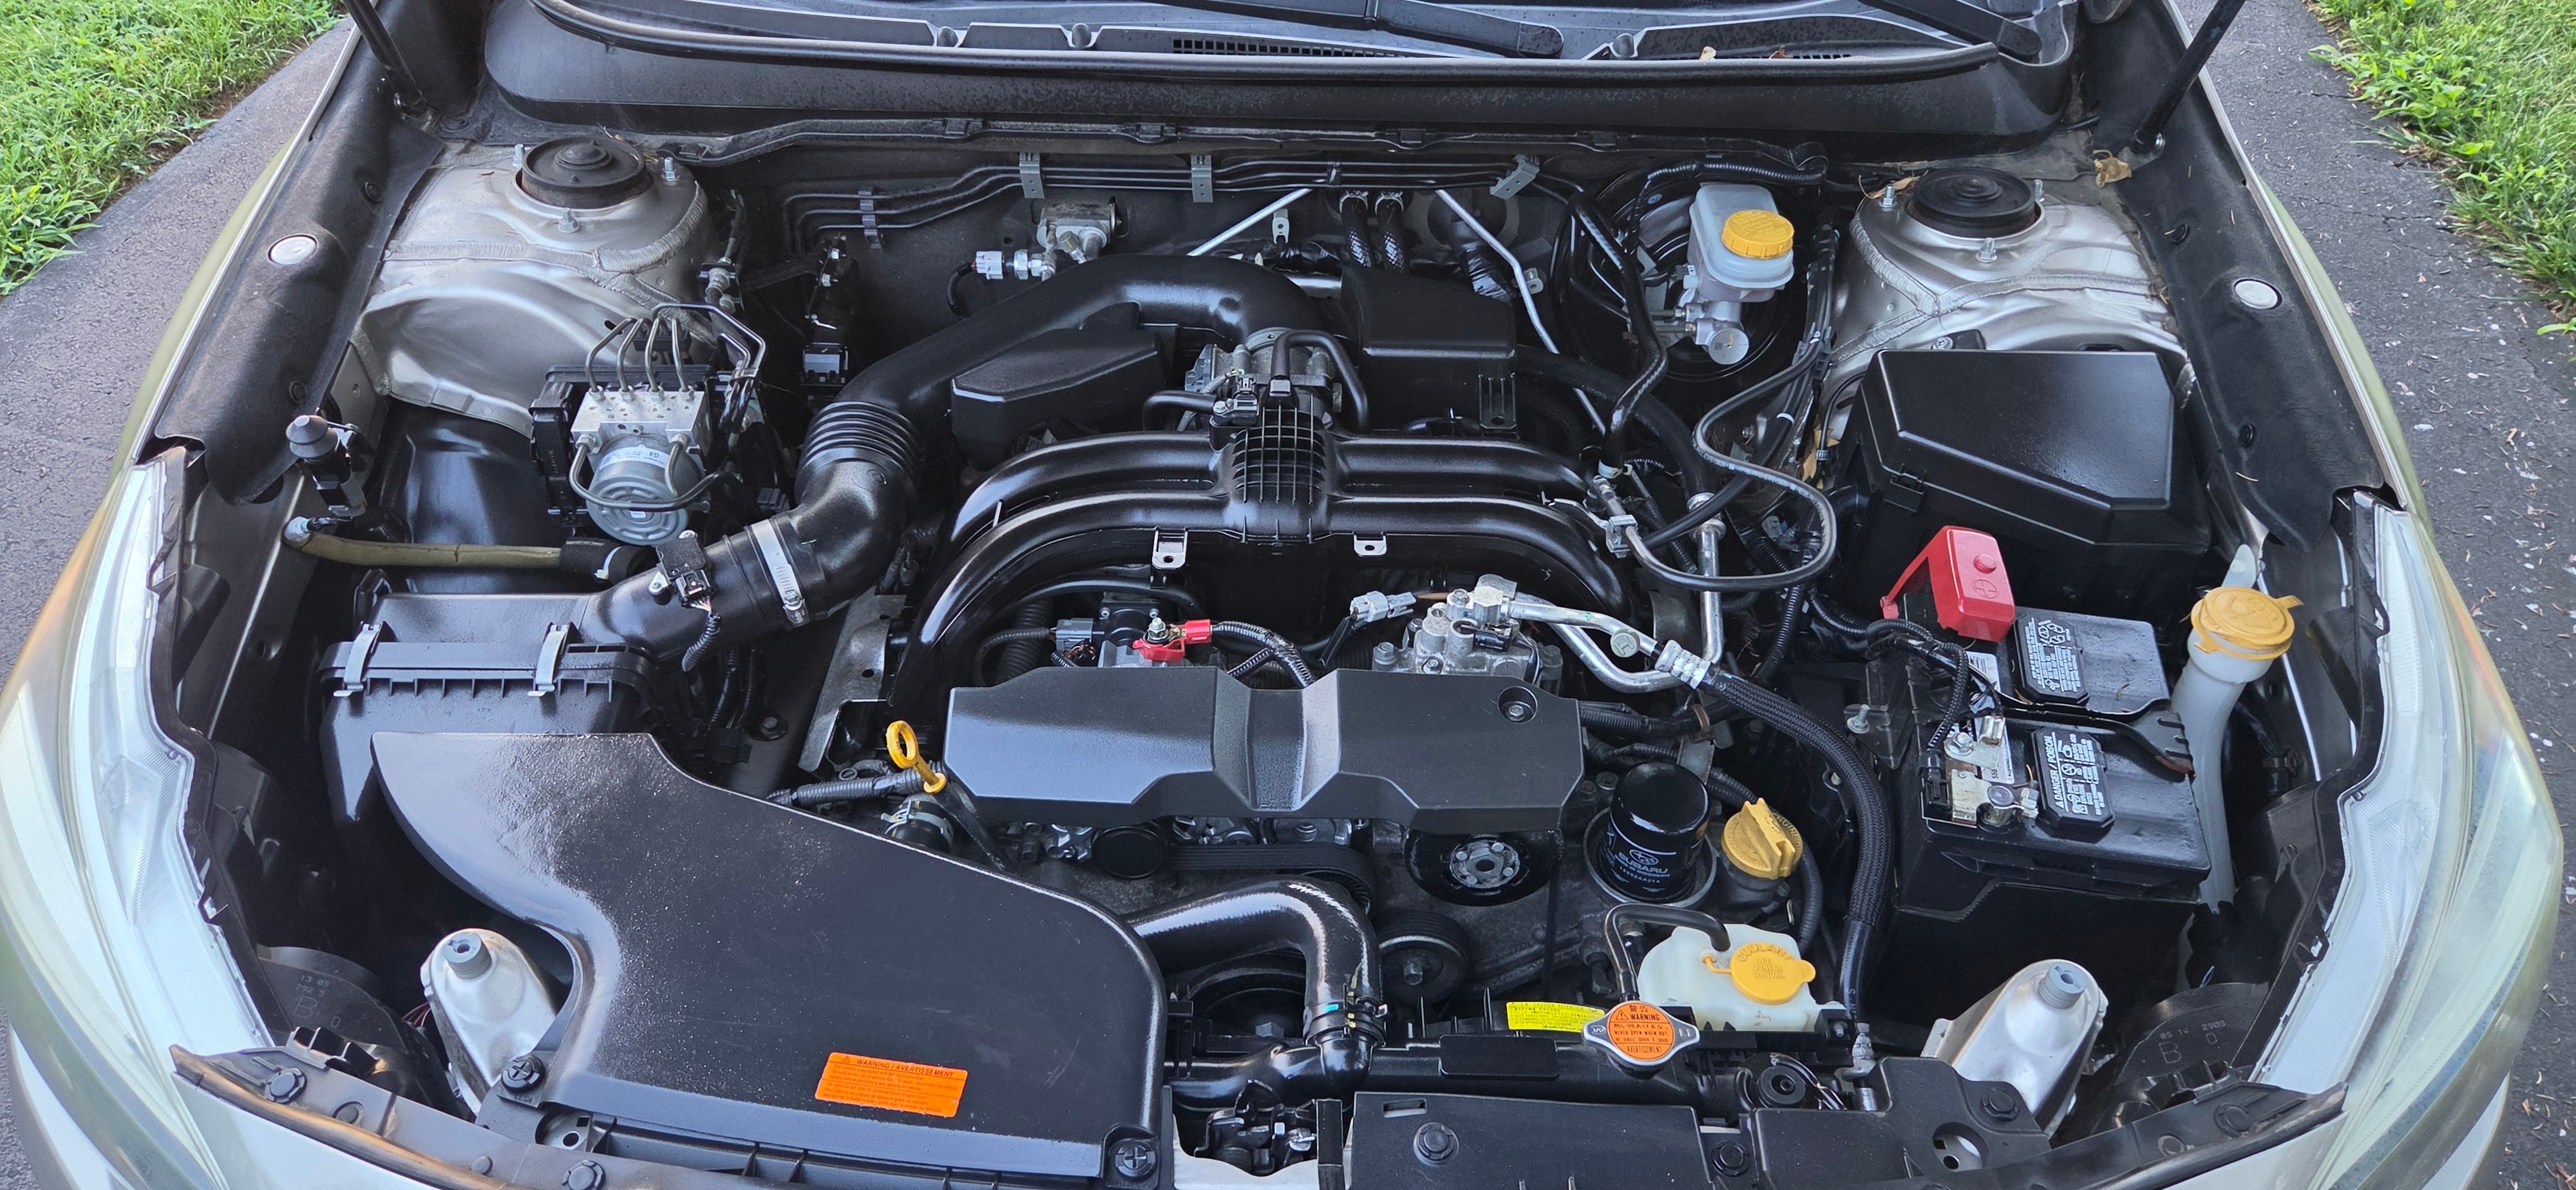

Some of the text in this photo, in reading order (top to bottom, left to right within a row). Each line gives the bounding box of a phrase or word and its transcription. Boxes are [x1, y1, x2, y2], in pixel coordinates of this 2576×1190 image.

[2043, 735, 2056, 763] POISON
[2049, 770, 2064, 802] DANGER
[1618, 852, 1668, 874] SUBARU
[1736, 943, 1793, 961] COOLANT
[294, 996, 319, 1019] B
[2158, 1041, 2182, 1064] B
[857, 1059, 891, 1069] WARNING
[896, 1064, 954, 1077] AVERTISSEMENT
